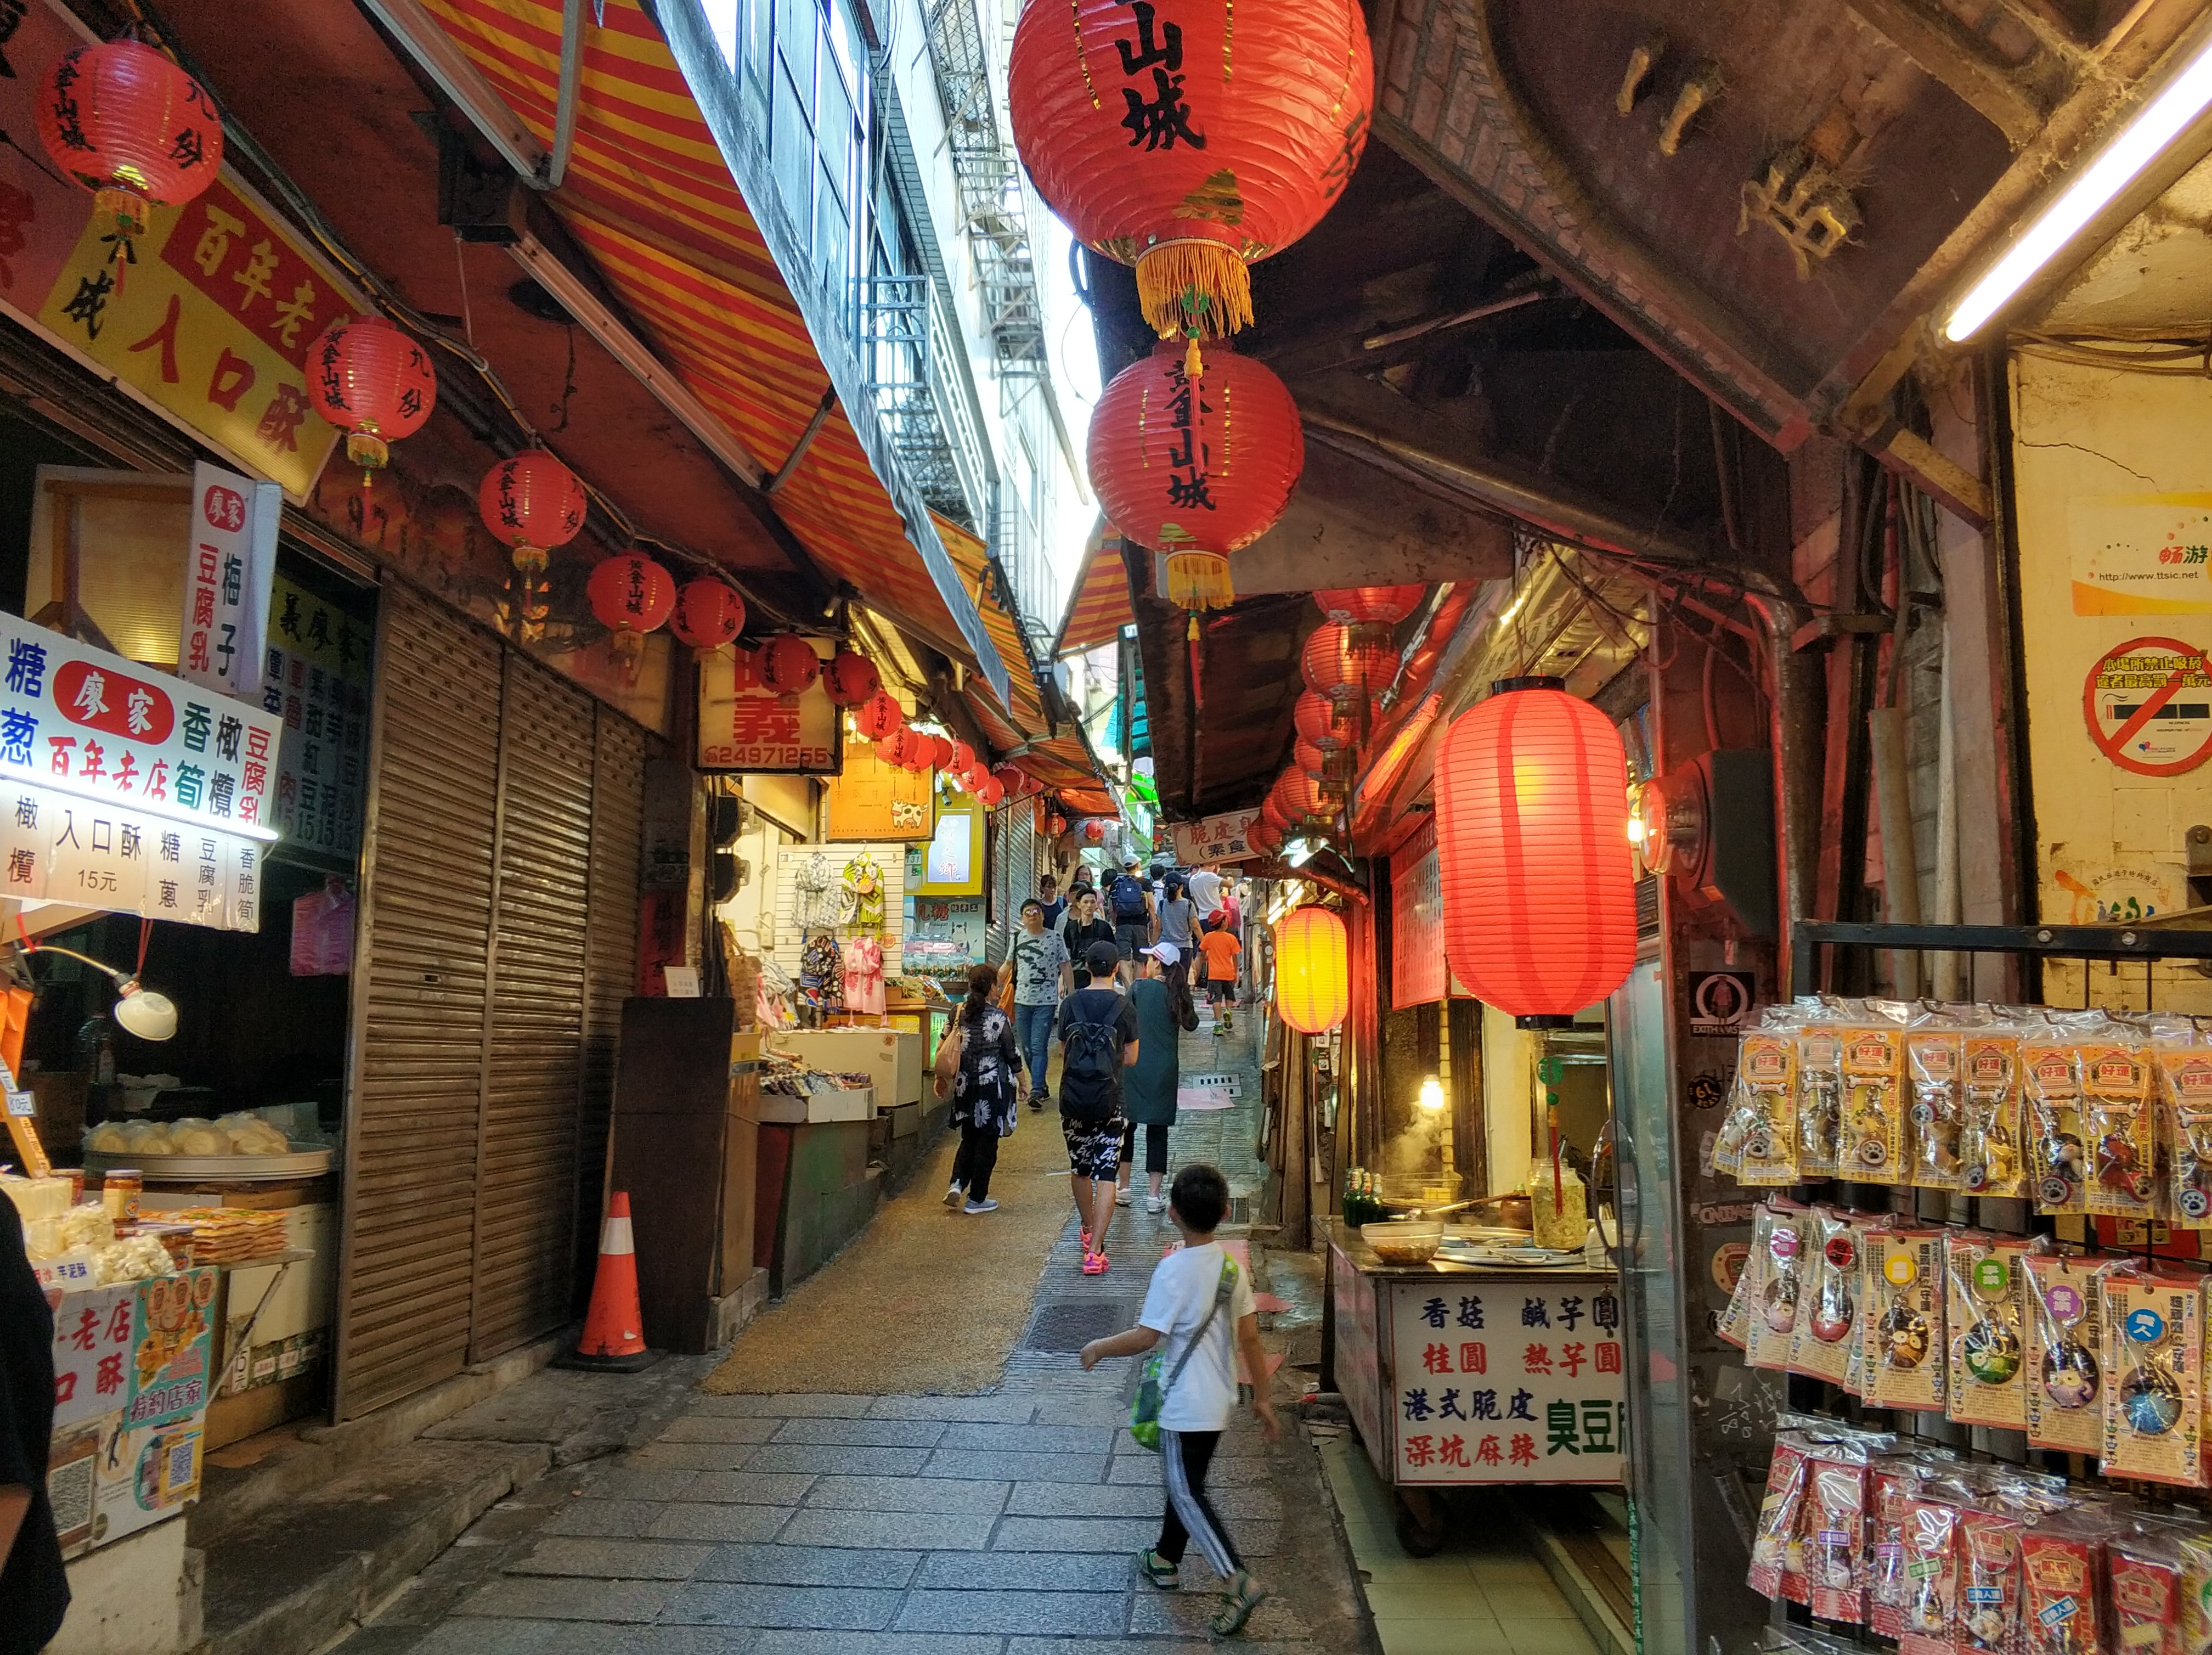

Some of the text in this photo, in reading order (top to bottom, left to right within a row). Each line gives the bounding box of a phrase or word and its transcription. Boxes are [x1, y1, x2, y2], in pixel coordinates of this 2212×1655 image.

[1115, 0, 1206, 151] 山城
[194, 204, 351, 350] 百年老
[128, 294, 314, 453] 入口酥
[2098, 570, 2199, 582] http://www.ttsic.net
[189, 543, 218, 673] 豆腐乳
[2096, 673, 2211, 689] 違者最高罰一萬元
[2102, 656, 2203, 672] 本場所禁止吸菸
[73, 671, 155, 735] 廖家
[47, 735, 170, 802] 百年老店
[237, 724, 272, 826] 豆腐乳
[55, 809, 142, 862] 入口酥
[77, 869, 118, 893] 15元
[57, 1298, 132, 1352] 老店
[1419, 1295, 1486, 1330] 香菇
[1521, 1295, 1620, 1332] 鹹芋圓
[1422, 1342, 1487, 1376] 桂圓
[1522, 1342, 1622, 1378] 熱芋圓
[129, 1378, 202, 1423] 特約店家
[1402, 1387, 1540, 1422] 港式脆皮
[1546, 1398, 1626, 1456] 臭豆
[1404, 1433, 1541, 1468] 深坑麻辣
